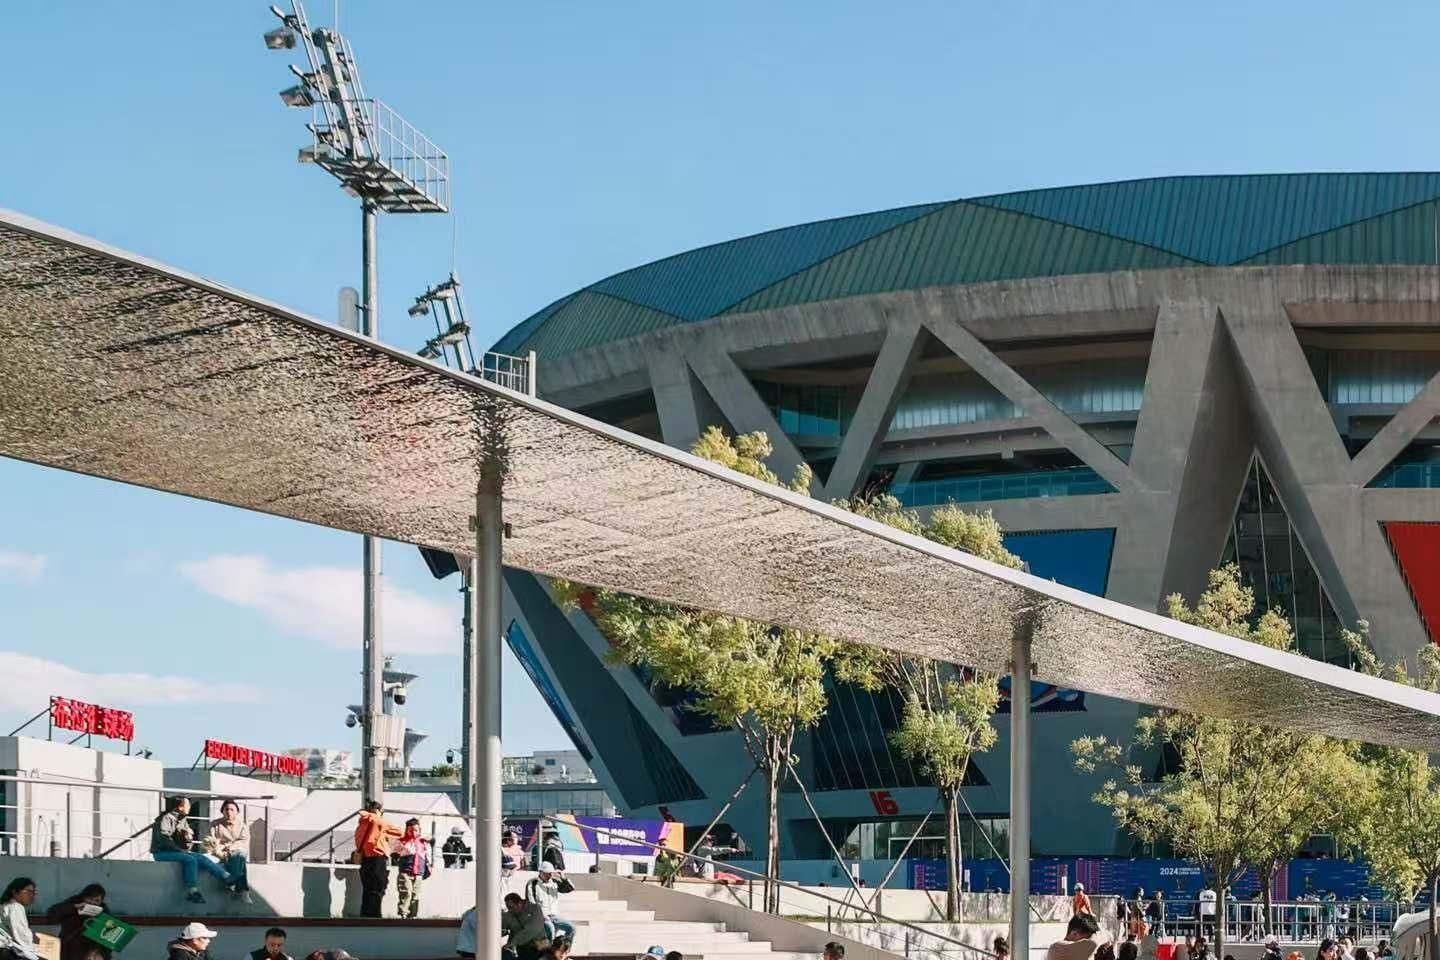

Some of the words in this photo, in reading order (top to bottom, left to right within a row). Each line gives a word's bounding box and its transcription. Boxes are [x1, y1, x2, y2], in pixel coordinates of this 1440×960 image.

[207, 741, 233, 761] BRAD
[278, 756, 304, 776] COURT
[869, 791, 898, 815] 16
[1160, 867, 1178, 875] 2024
